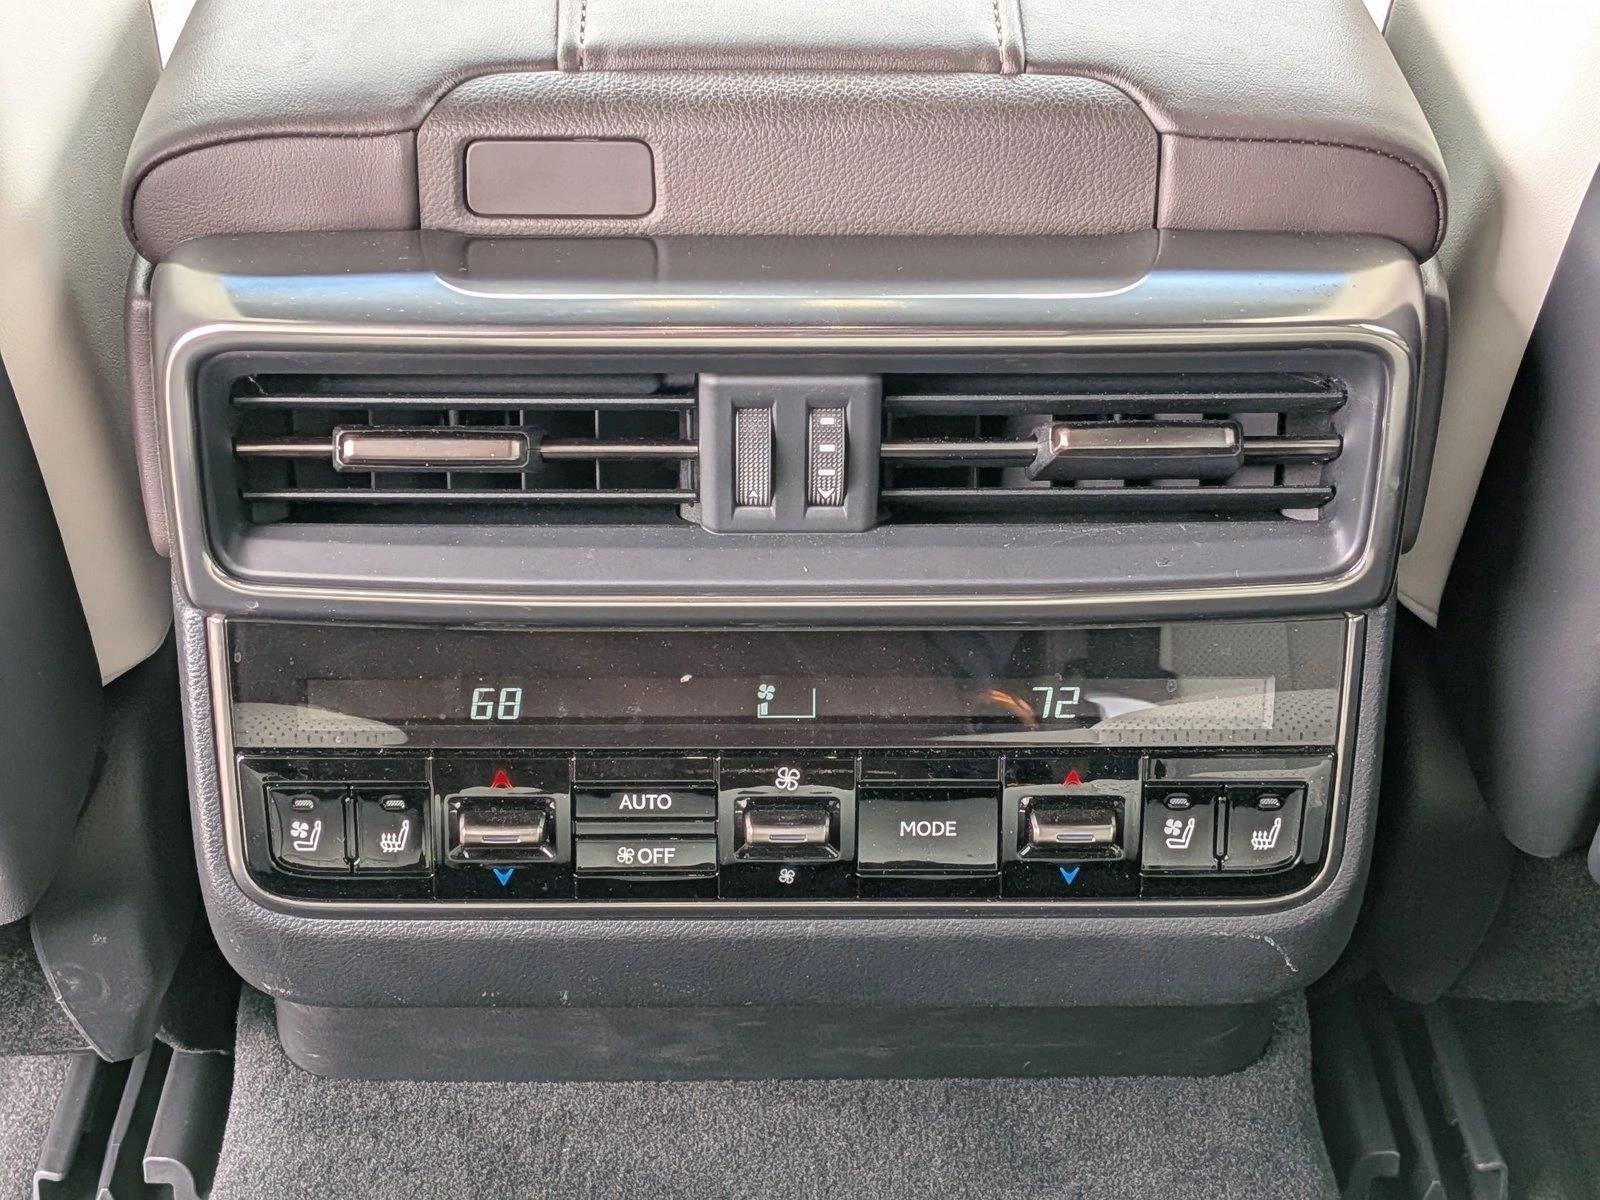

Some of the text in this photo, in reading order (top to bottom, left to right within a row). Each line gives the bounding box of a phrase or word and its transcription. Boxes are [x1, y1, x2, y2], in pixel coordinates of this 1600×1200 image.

[470, 687, 522, 720] 68
[1032, 686, 1081, 719] 72
[618, 793, 673, 810] AUTO
[899, 820, 957, 837] MODE
[637, 847, 676, 864] OFF
